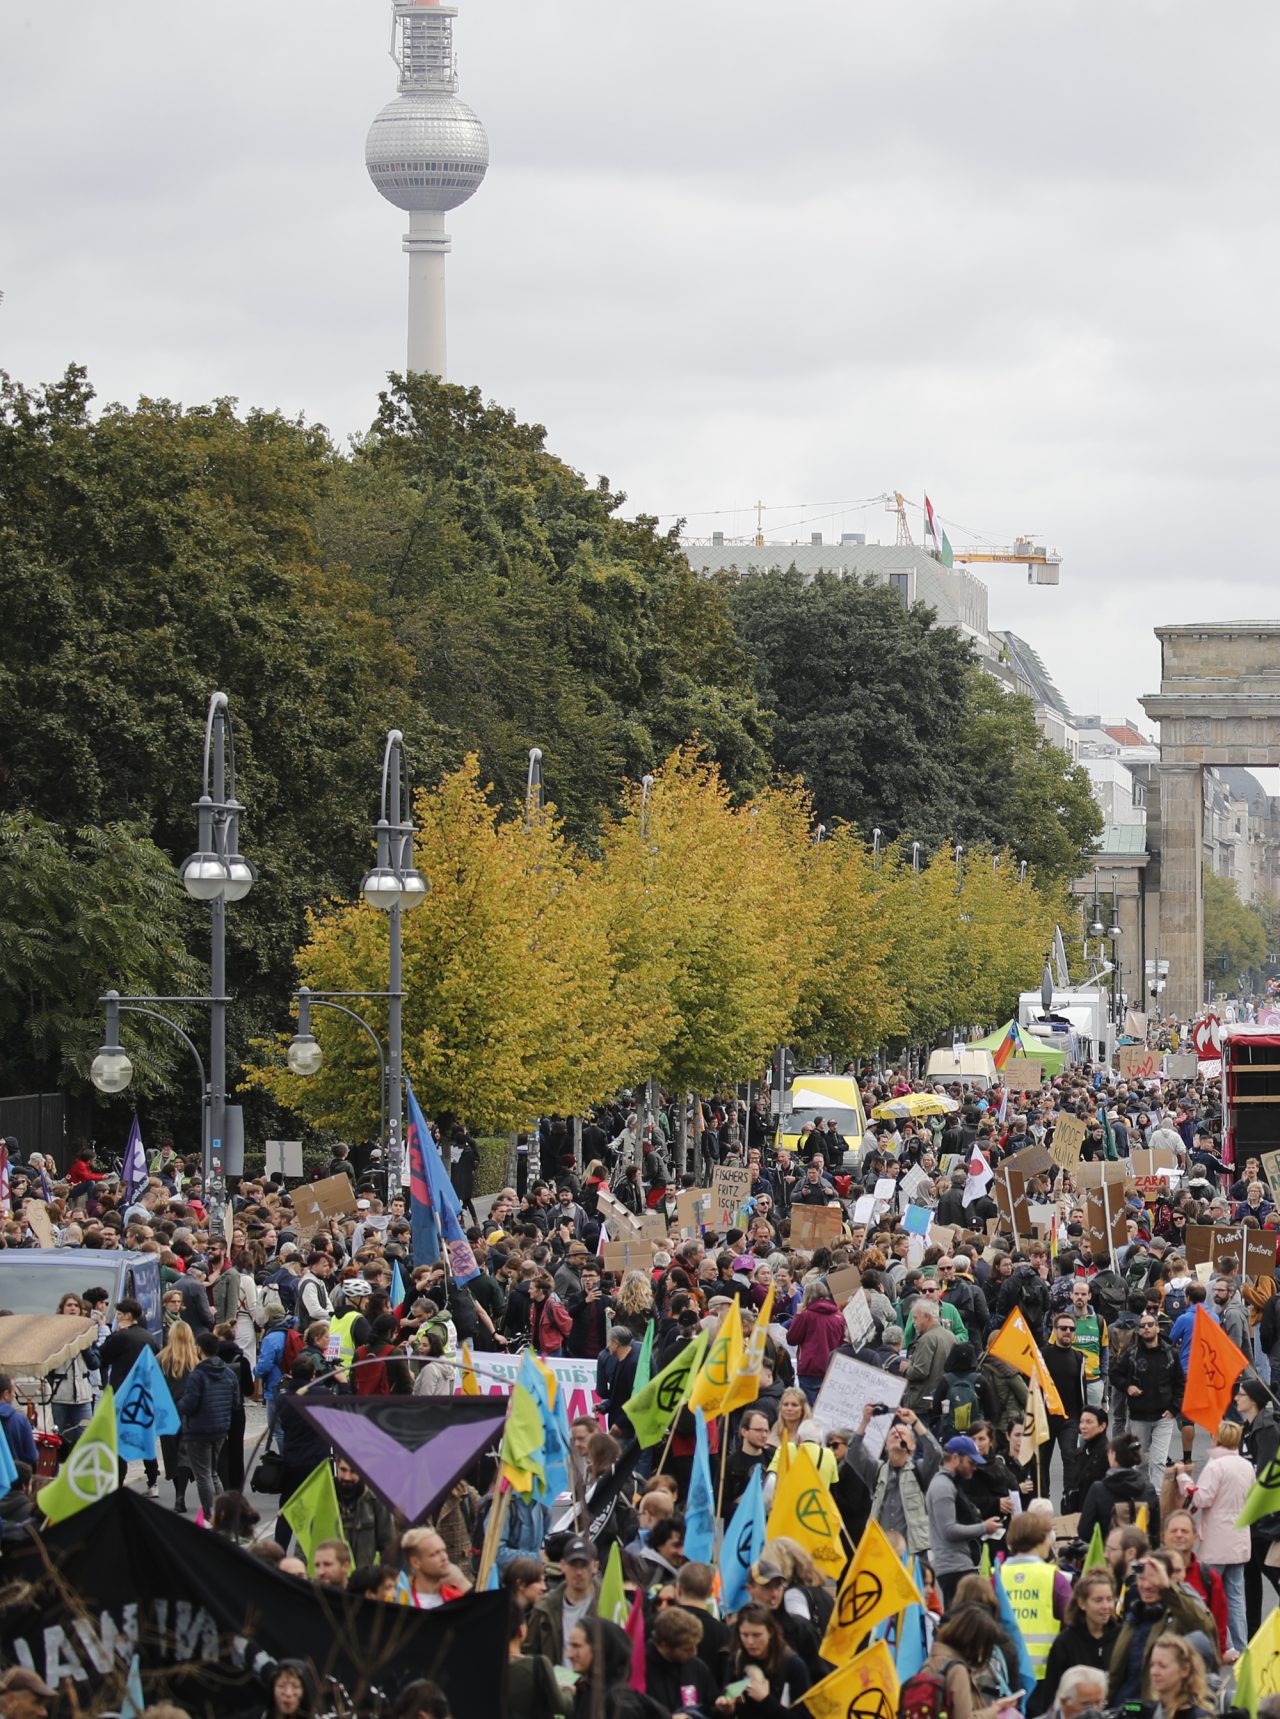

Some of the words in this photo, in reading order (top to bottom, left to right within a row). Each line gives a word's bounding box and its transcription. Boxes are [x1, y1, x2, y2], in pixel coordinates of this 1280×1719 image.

[1057, 1122, 1081, 1149] MODE
[715, 1168, 749, 1183] FISCHERS
[1134, 1176, 1167, 1187] ZARA
[718, 1184, 738, 1197] FRITZ
[719, 1198, 741, 1211] ISCHT
[1216, 1230, 1243, 1245] Protect
